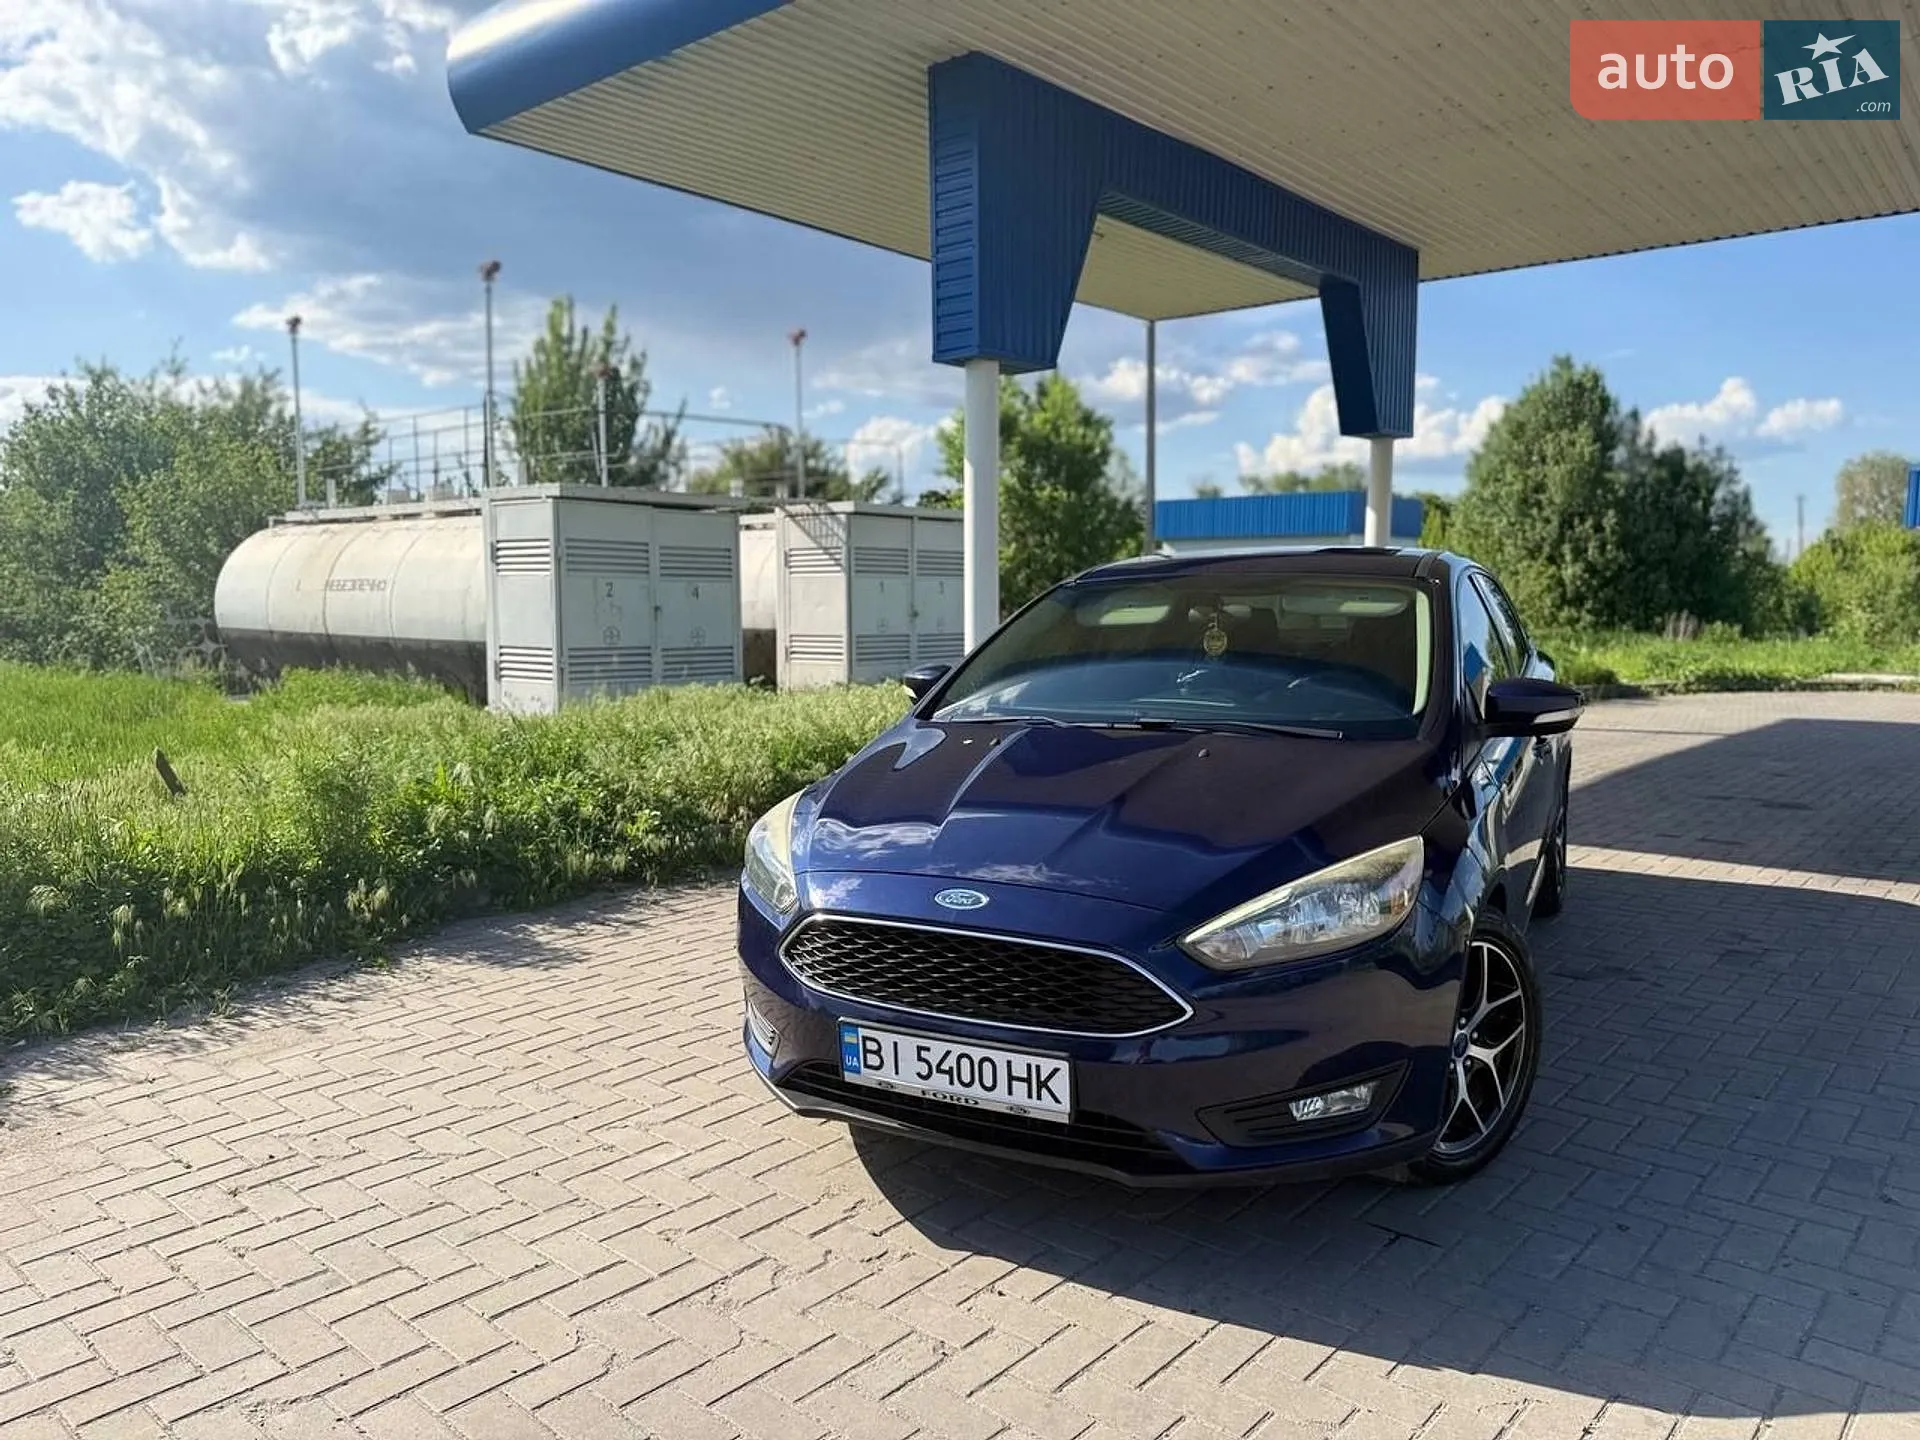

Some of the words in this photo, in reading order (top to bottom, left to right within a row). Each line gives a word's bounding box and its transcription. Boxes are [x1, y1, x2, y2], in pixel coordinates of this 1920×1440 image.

[604, 581, 615, 599] 2
[845, 1055, 859, 1067] UA
[862, 1035, 899, 1076] BI
[916, 1044, 998, 1092] 5400
[1006, 1060, 1063, 1105] HK
